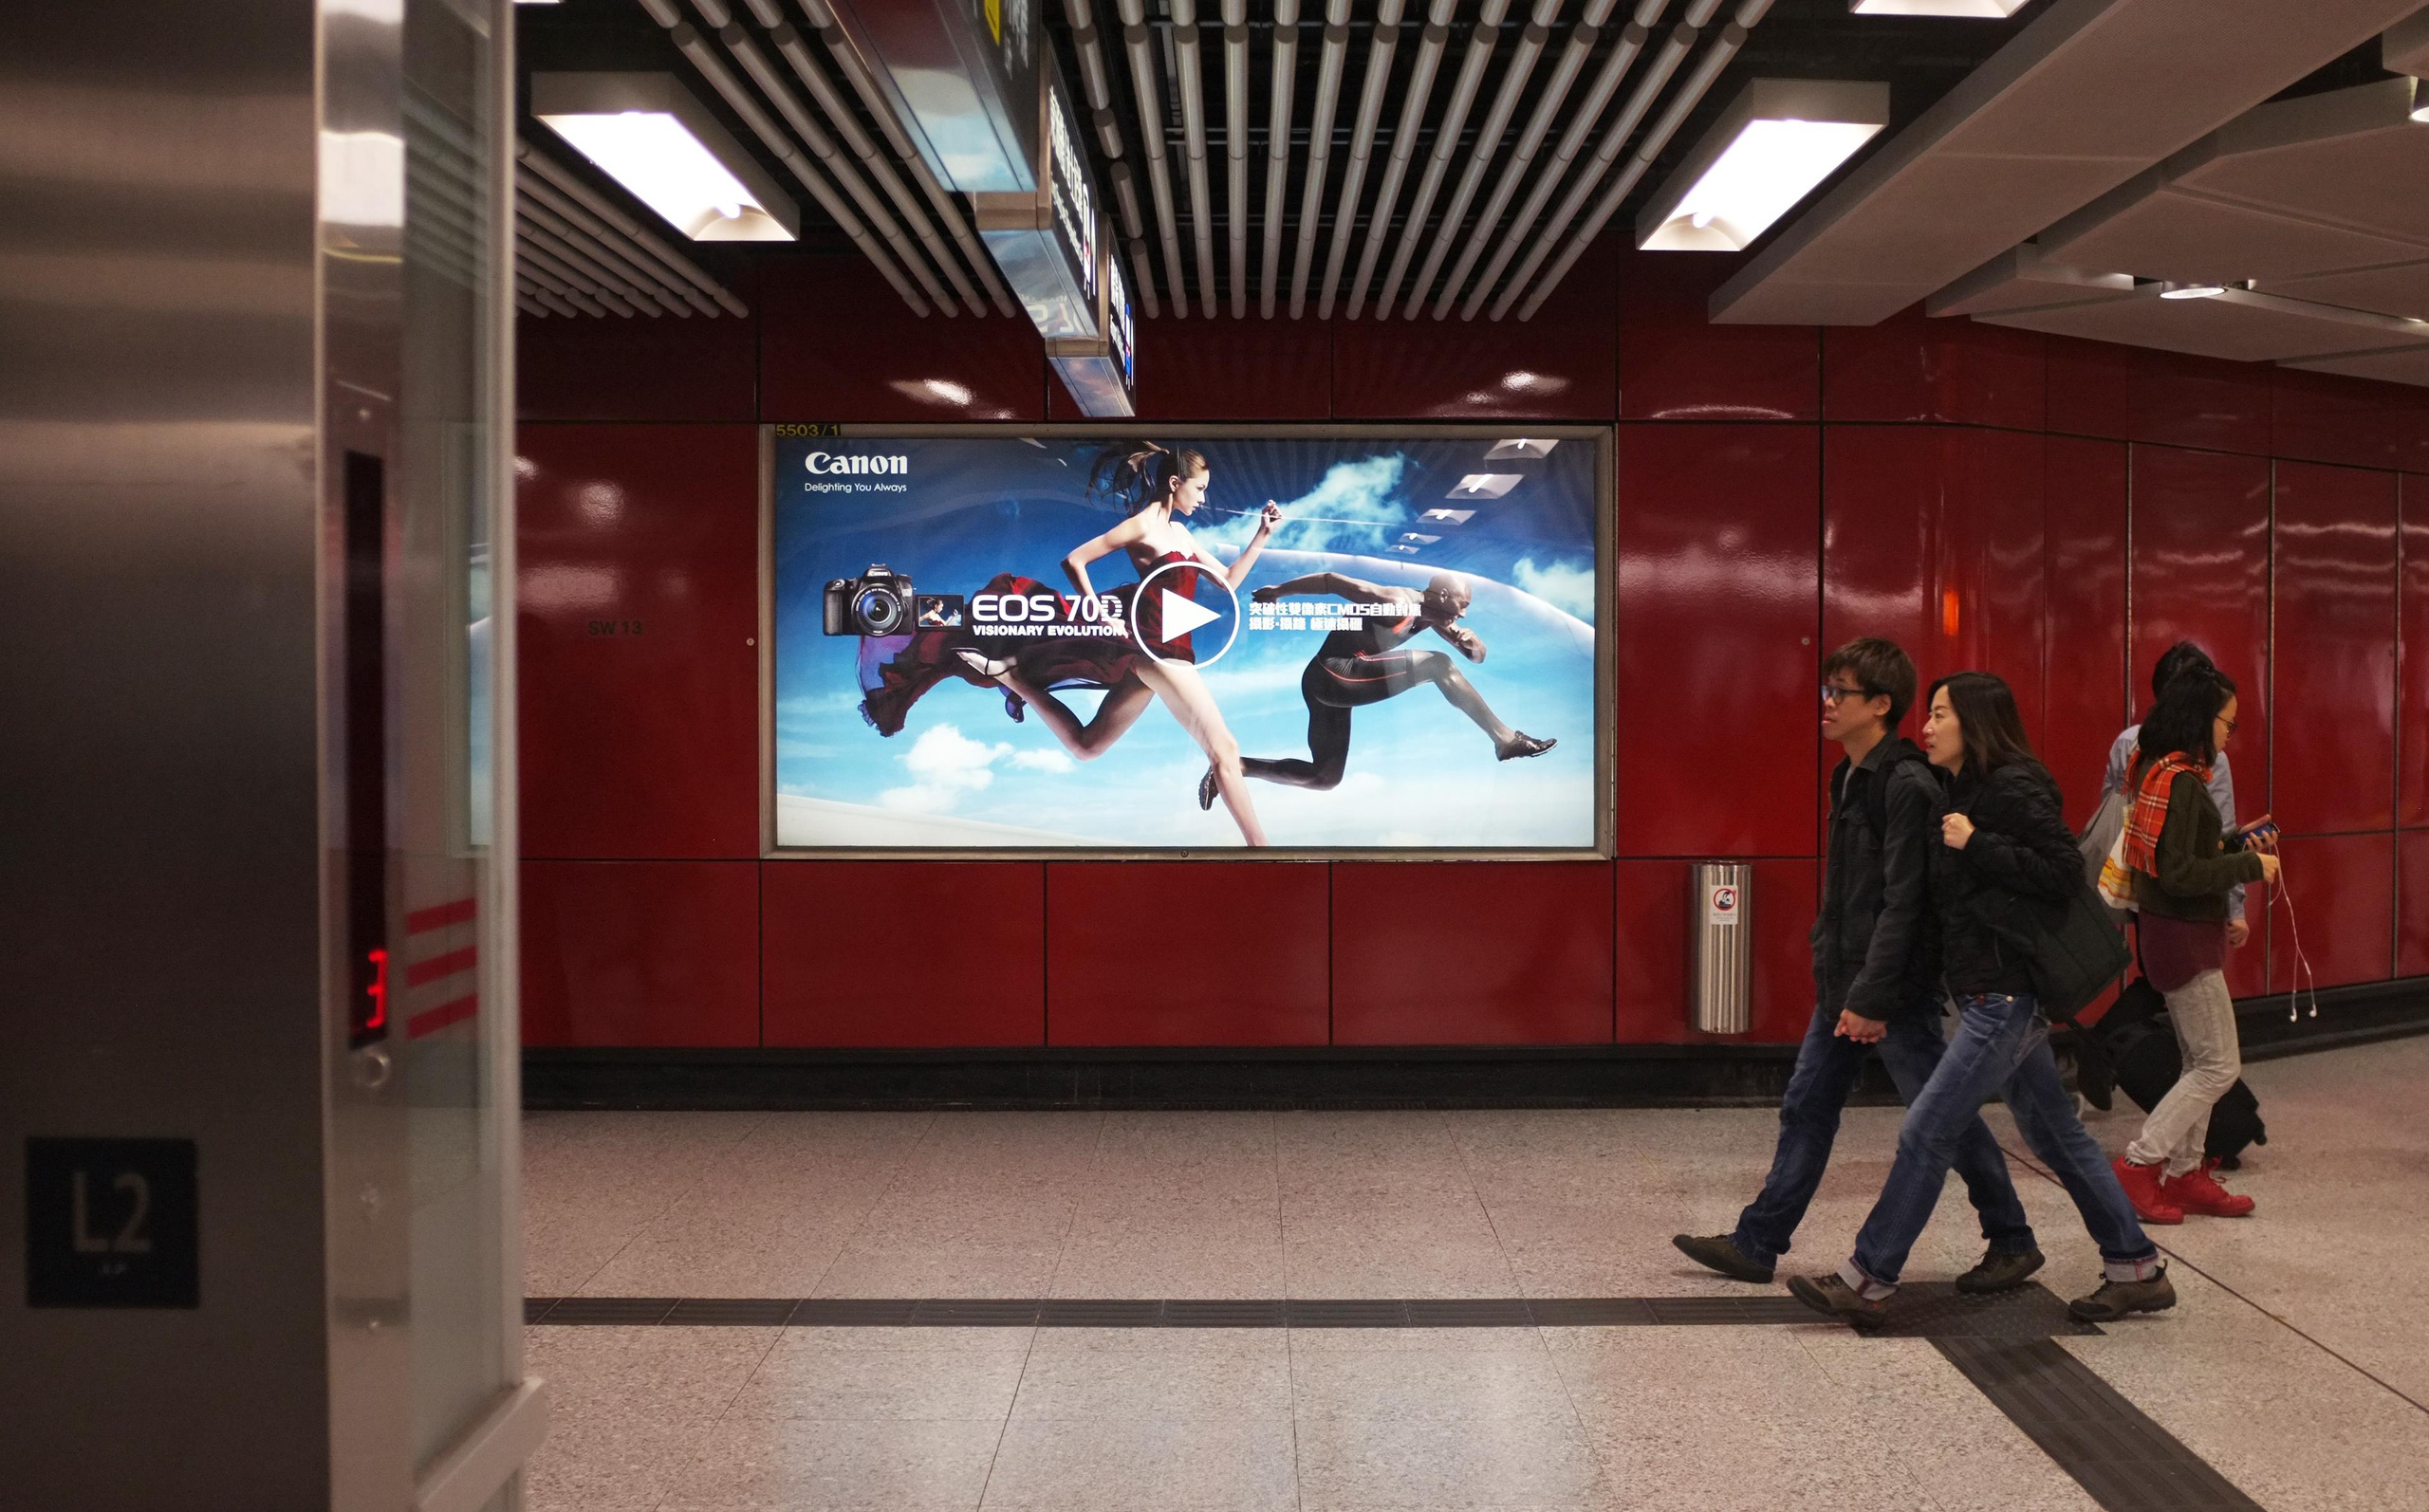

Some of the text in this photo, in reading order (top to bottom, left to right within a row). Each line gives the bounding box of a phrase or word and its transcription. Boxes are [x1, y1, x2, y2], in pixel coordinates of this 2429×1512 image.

[805, 452, 908, 474] Canon
[805, 483, 907, 493] Delighting You Always
[973, 595, 1123, 622] EOS 70D
[588, 619, 643, 636] SW 13
[973, 625, 1123, 636] VISIONARY EVOLUTION
[71, 1171, 152, 1252] L2
